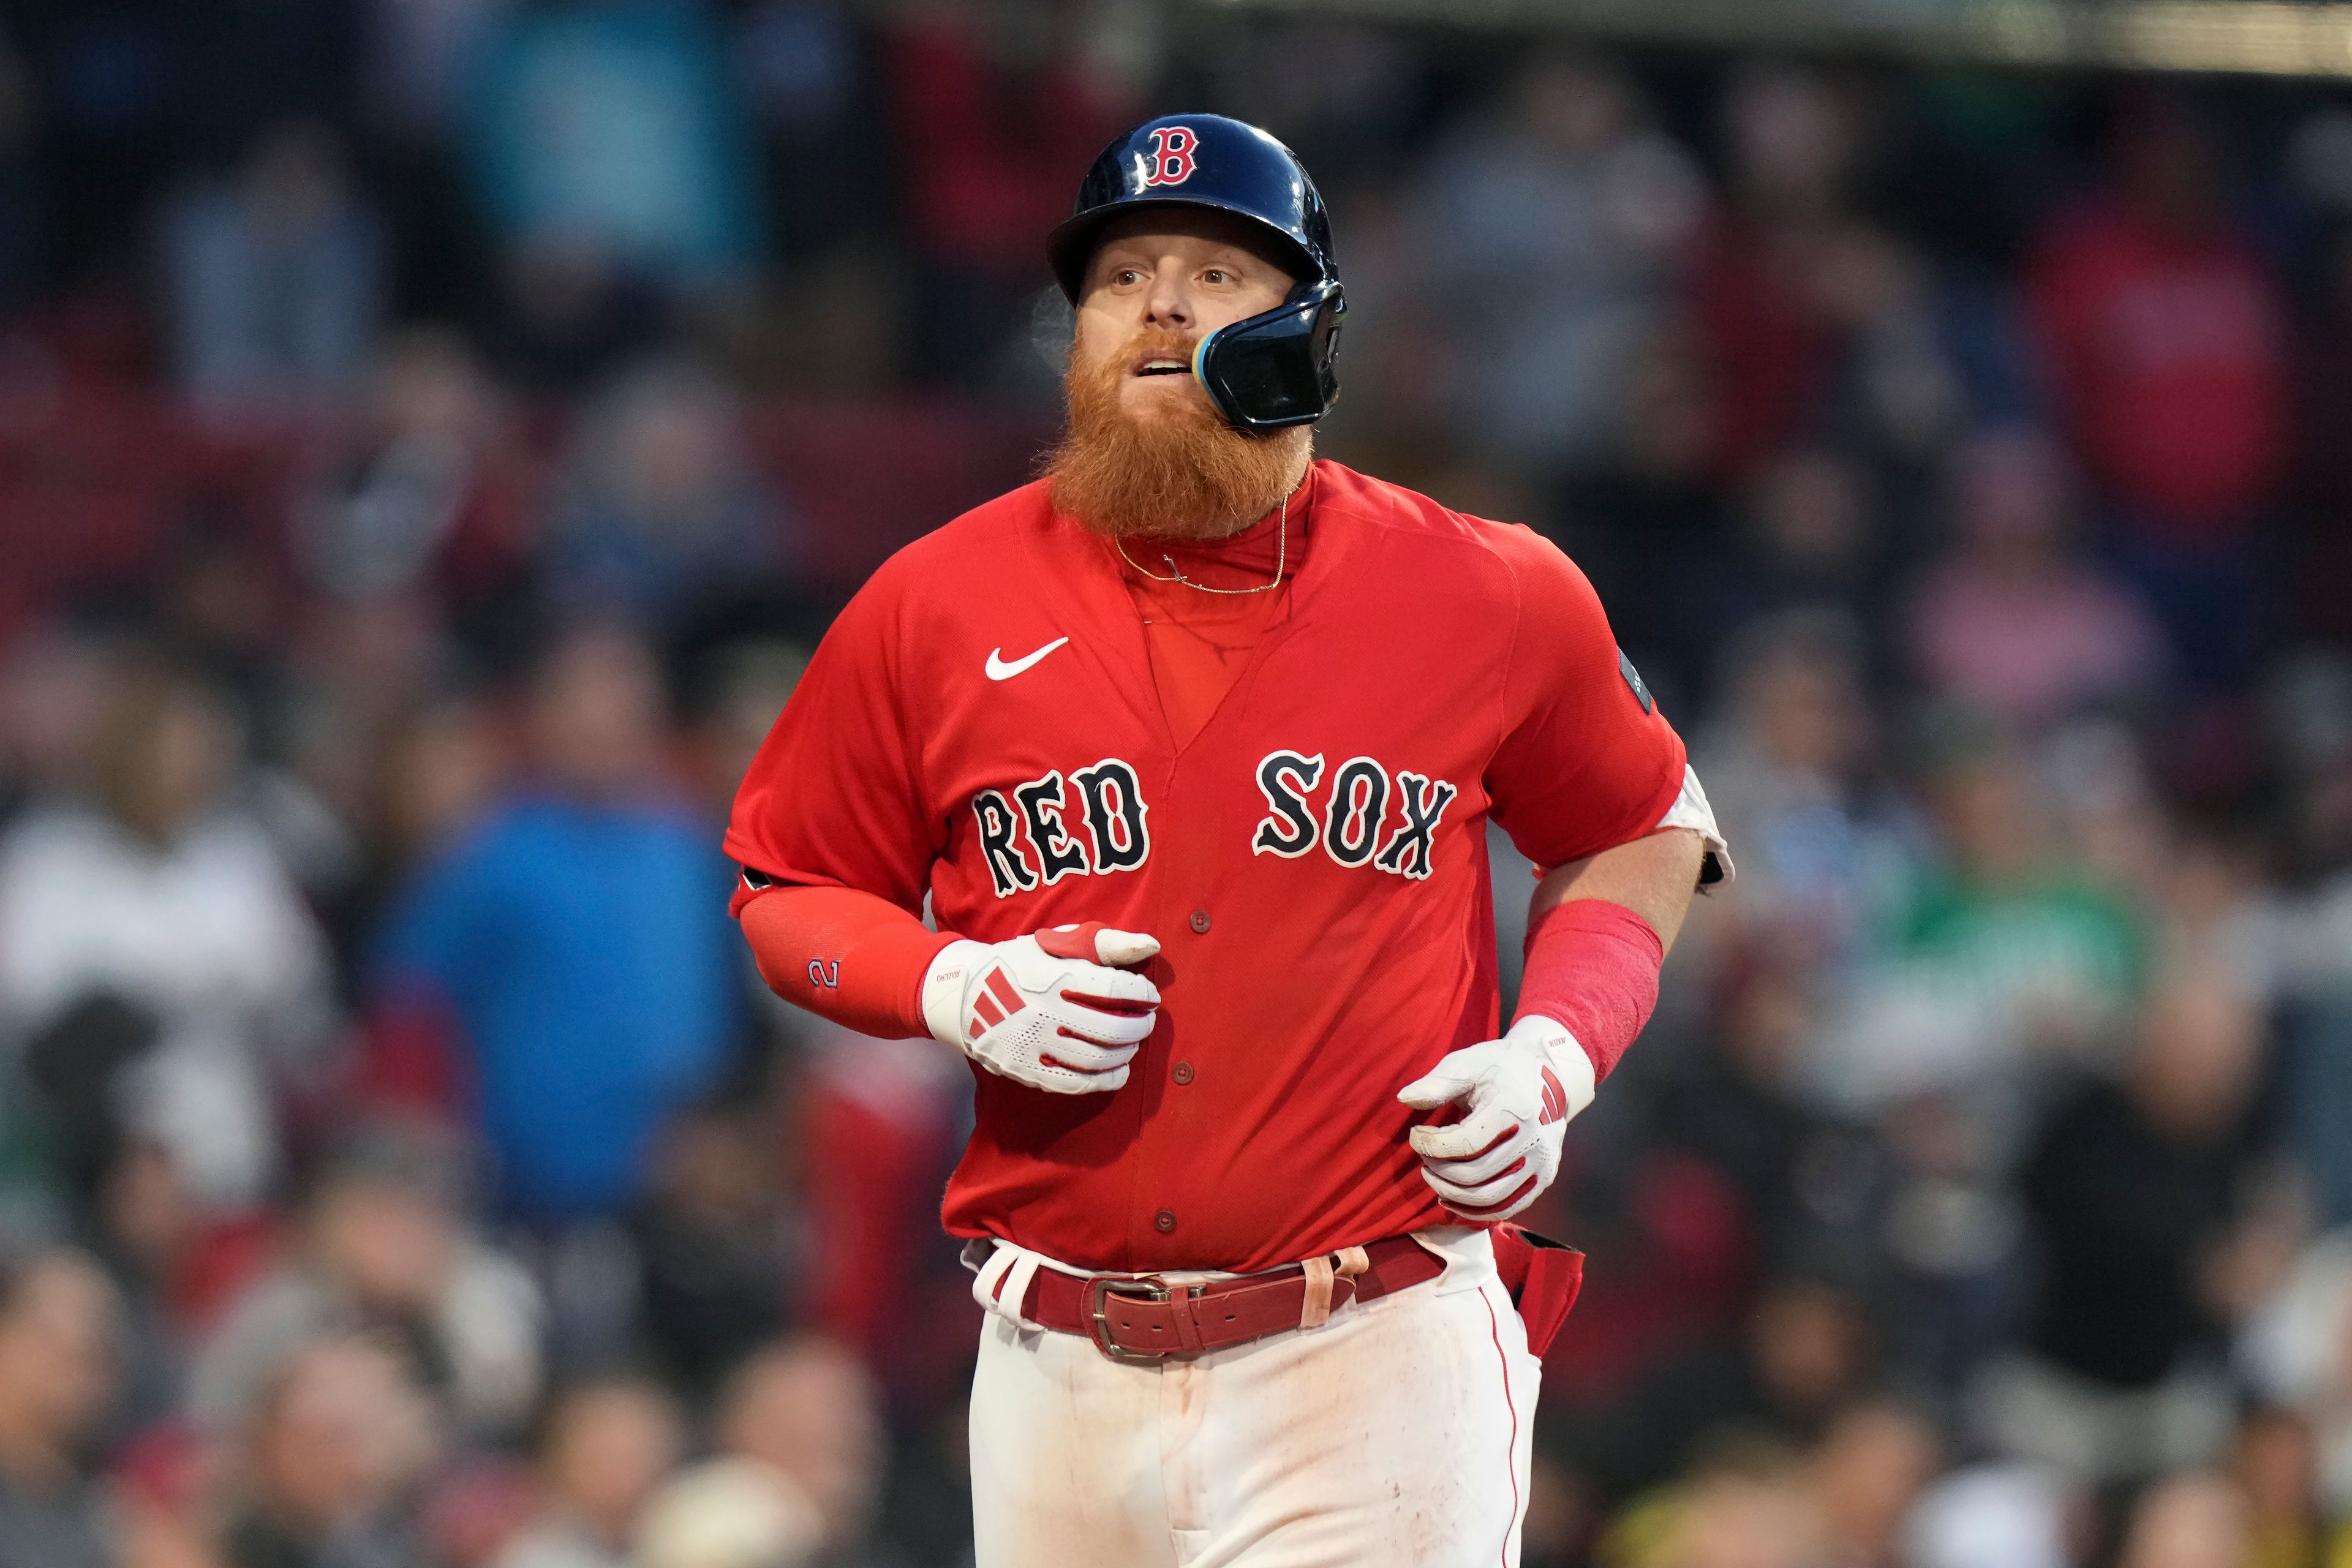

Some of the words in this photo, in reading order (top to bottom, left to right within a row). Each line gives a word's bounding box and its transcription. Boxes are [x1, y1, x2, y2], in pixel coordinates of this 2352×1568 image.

[1147, 126, 1200, 186] B
[971, 758, 1150, 899] RED
[1252, 749, 1457, 881] SOX
[808, 959, 839, 988] 2
[937, 970, 960, 982] ADIZERO
